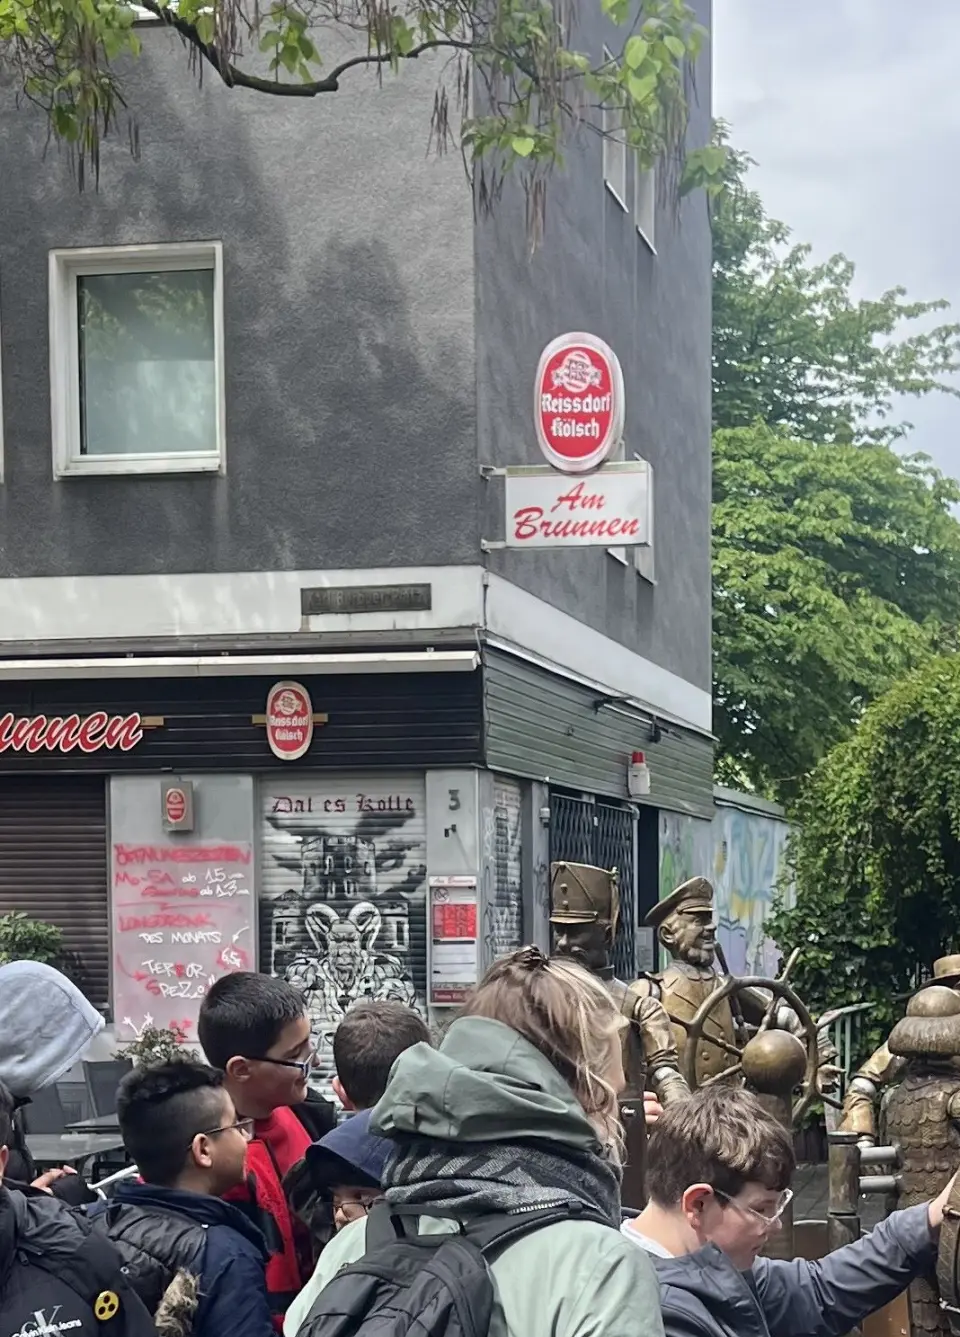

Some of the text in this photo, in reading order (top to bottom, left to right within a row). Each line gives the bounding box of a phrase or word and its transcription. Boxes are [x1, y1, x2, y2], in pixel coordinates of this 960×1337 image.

[542, 392, 612, 413] Reissdorf
[551, 417, 600, 440] Kölsch
[551, 481, 606, 513] Am
[513, 506, 640, 540] Brunnen
[323, 798, 346, 813] es
[448, 789, 461, 811] 3
[205, 867, 226, 884] 15
[171, 930, 222, 944] MONATS
